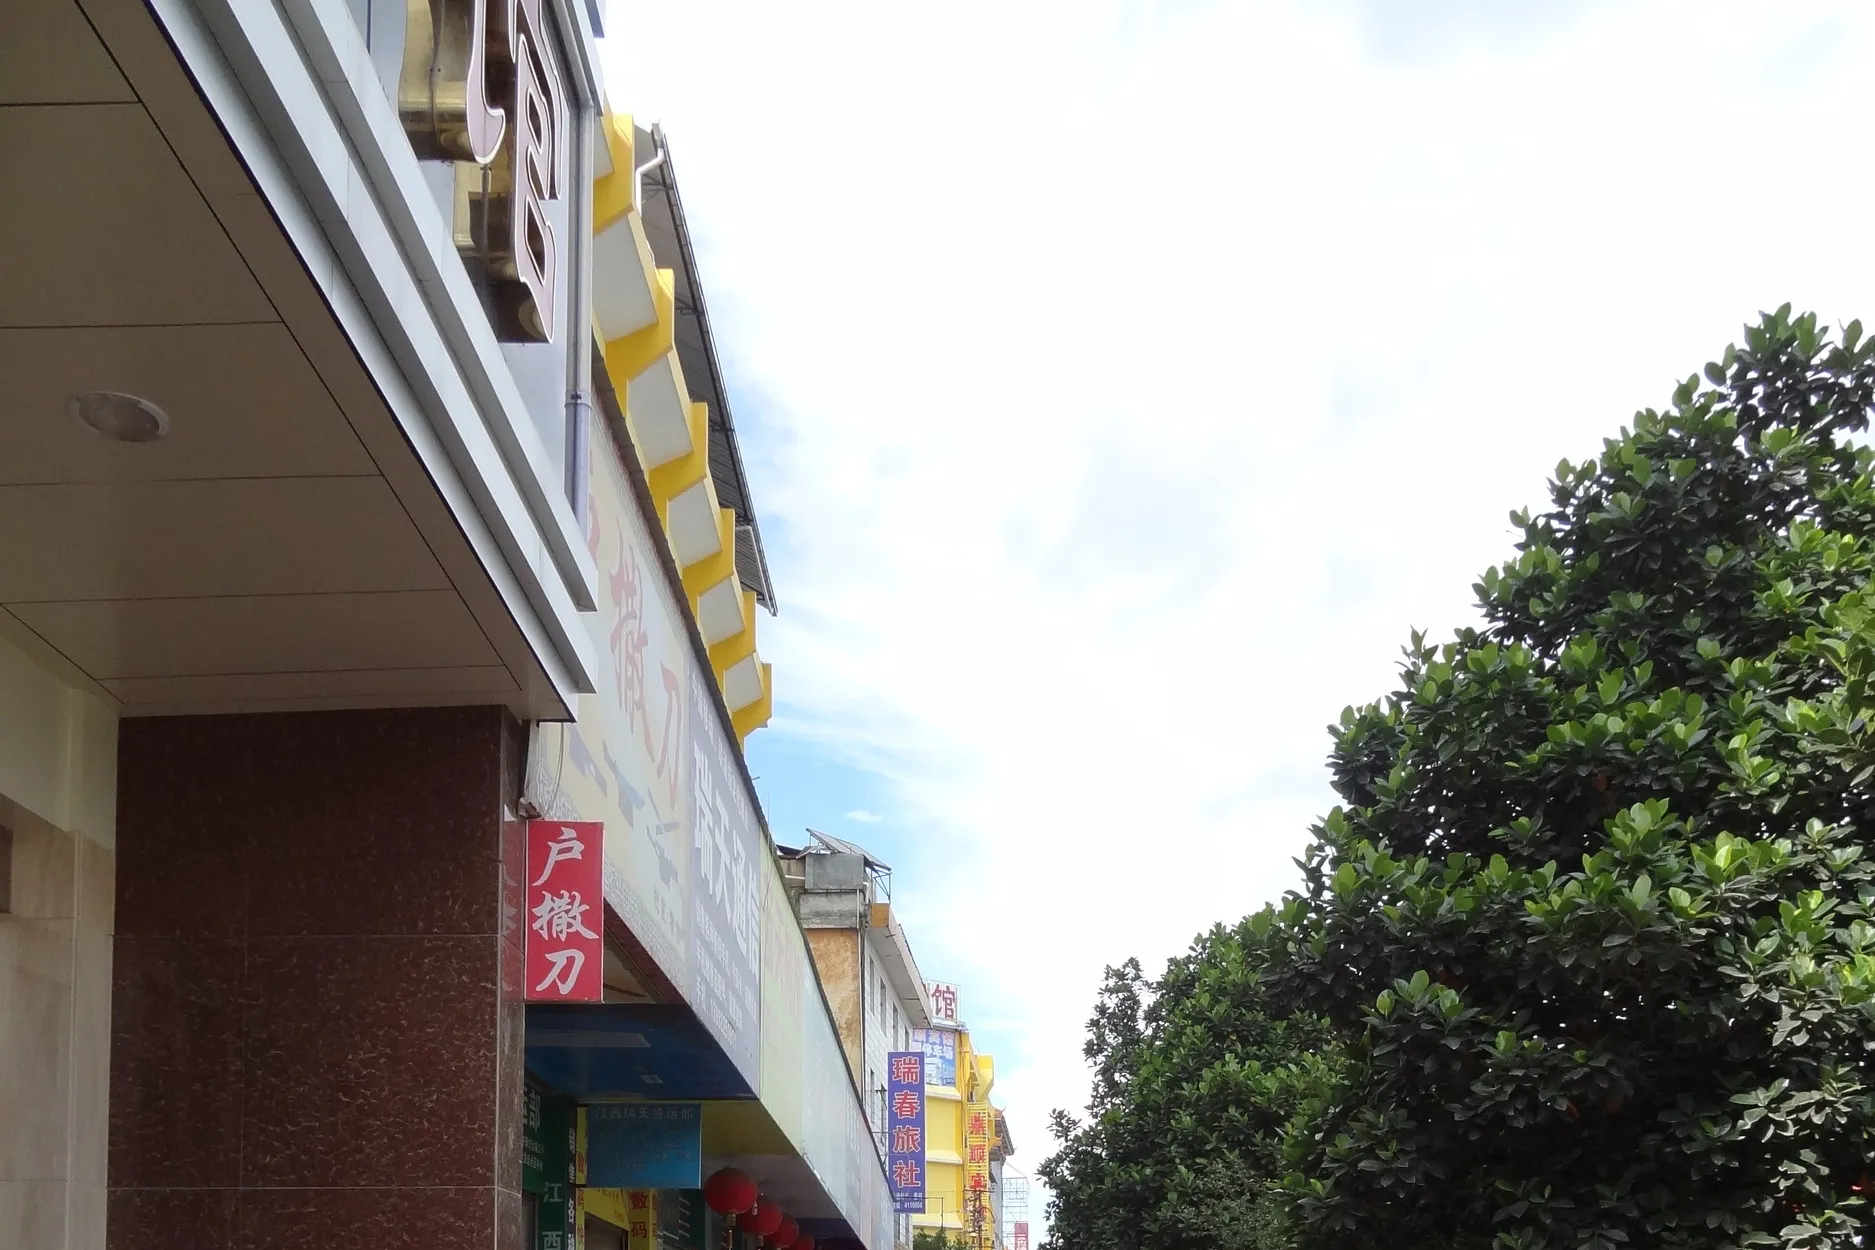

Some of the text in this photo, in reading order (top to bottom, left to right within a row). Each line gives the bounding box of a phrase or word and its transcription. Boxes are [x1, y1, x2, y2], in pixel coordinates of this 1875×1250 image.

[532, 825, 600, 996] 户撒刀
[693, 736, 759, 985] 瑞天通信
[923, 983, 957, 1020] 馆
[892, 1056, 921, 1188] 瑞春旅社
